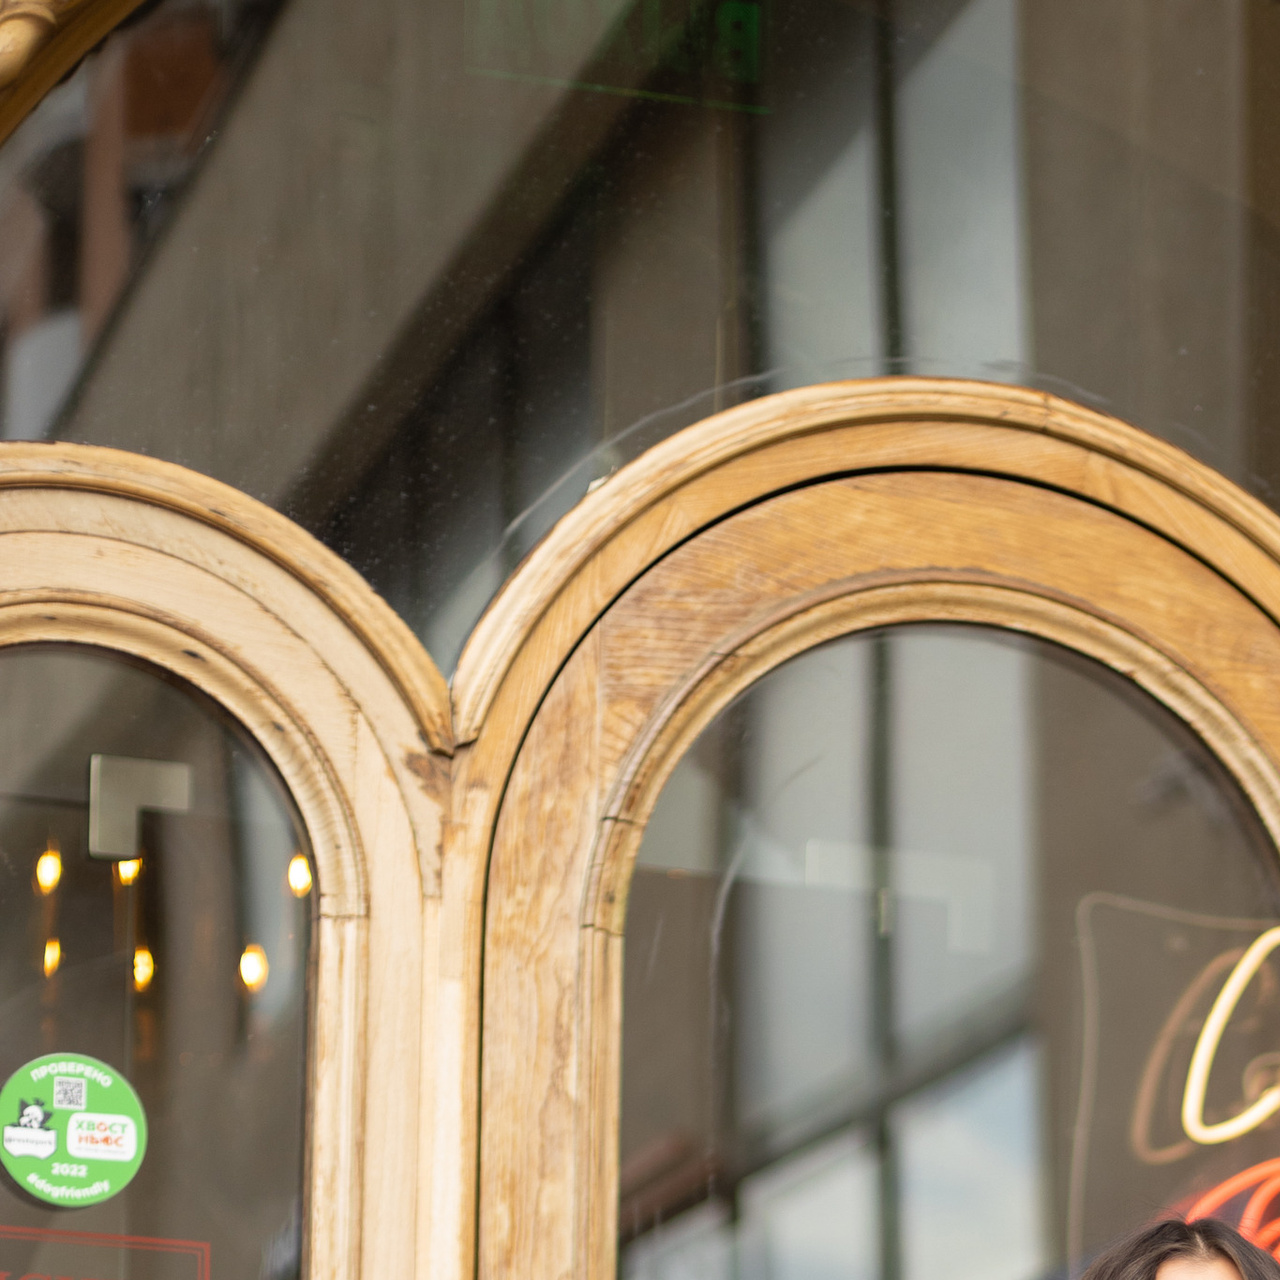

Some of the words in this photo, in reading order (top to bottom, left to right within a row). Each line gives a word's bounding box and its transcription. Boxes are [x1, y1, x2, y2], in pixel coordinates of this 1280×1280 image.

[30, 1062, 112, 1088] ПРОВЕРЕНО
[76, 1120, 127, 1134] ХВОСТ
[51, 1163, 87, 1177] 2022
[27, 1173, 110, 1199] #dogfriendly
